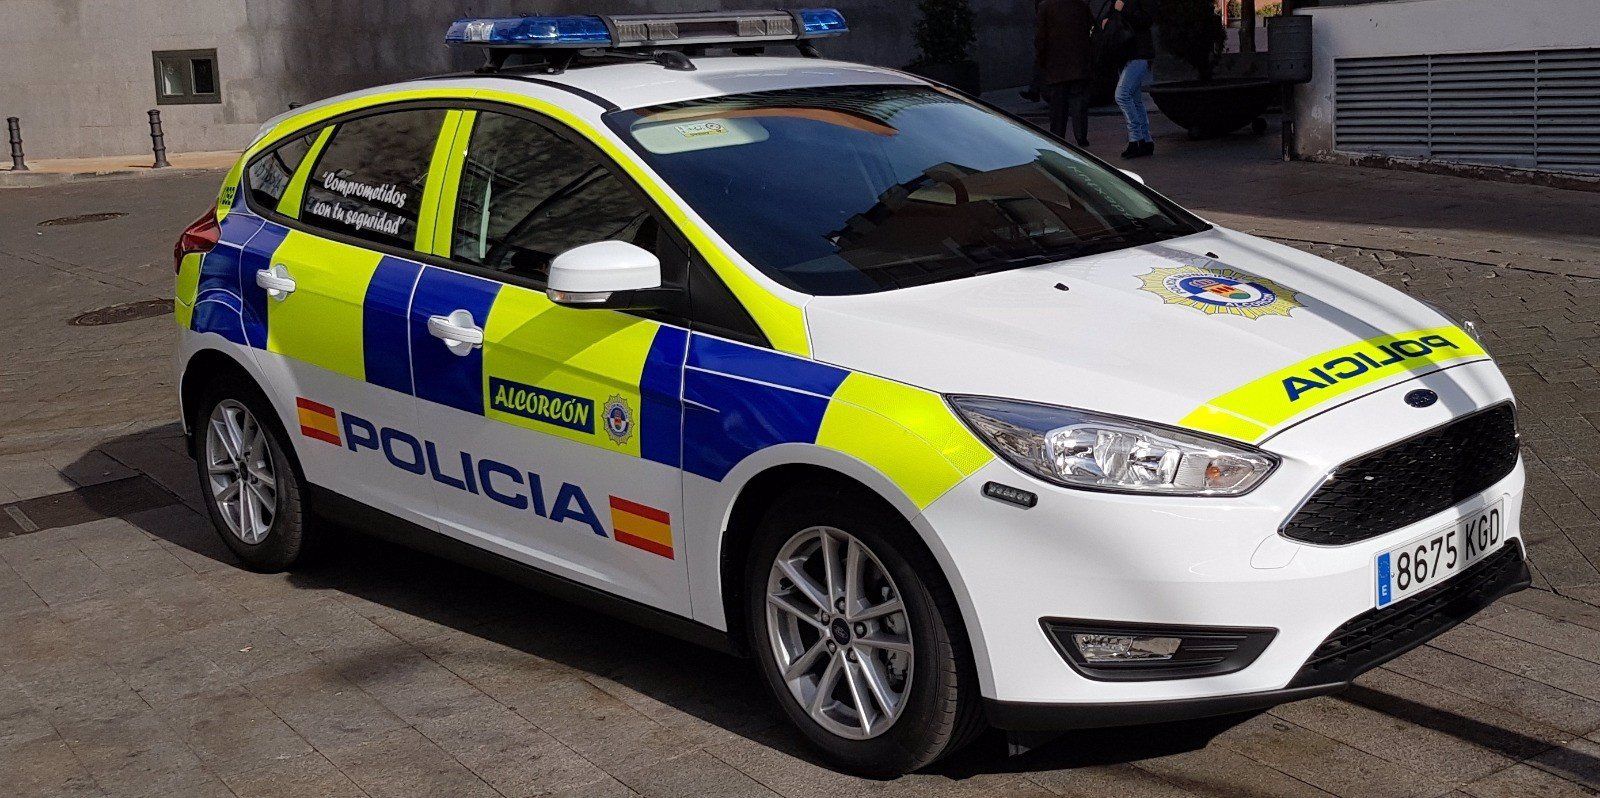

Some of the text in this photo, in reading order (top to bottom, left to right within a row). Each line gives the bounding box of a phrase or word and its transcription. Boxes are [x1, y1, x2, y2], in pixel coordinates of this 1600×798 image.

[313, 202, 331, 218] con
[332, 202, 345, 220] tu
[494, 384, 590, 426] ALCORCÓN
[341, 411, 609, 538] POLICIA
[1397, 530, 1458, 591] 8675
[1465, 508, 1500, 561] KGD
